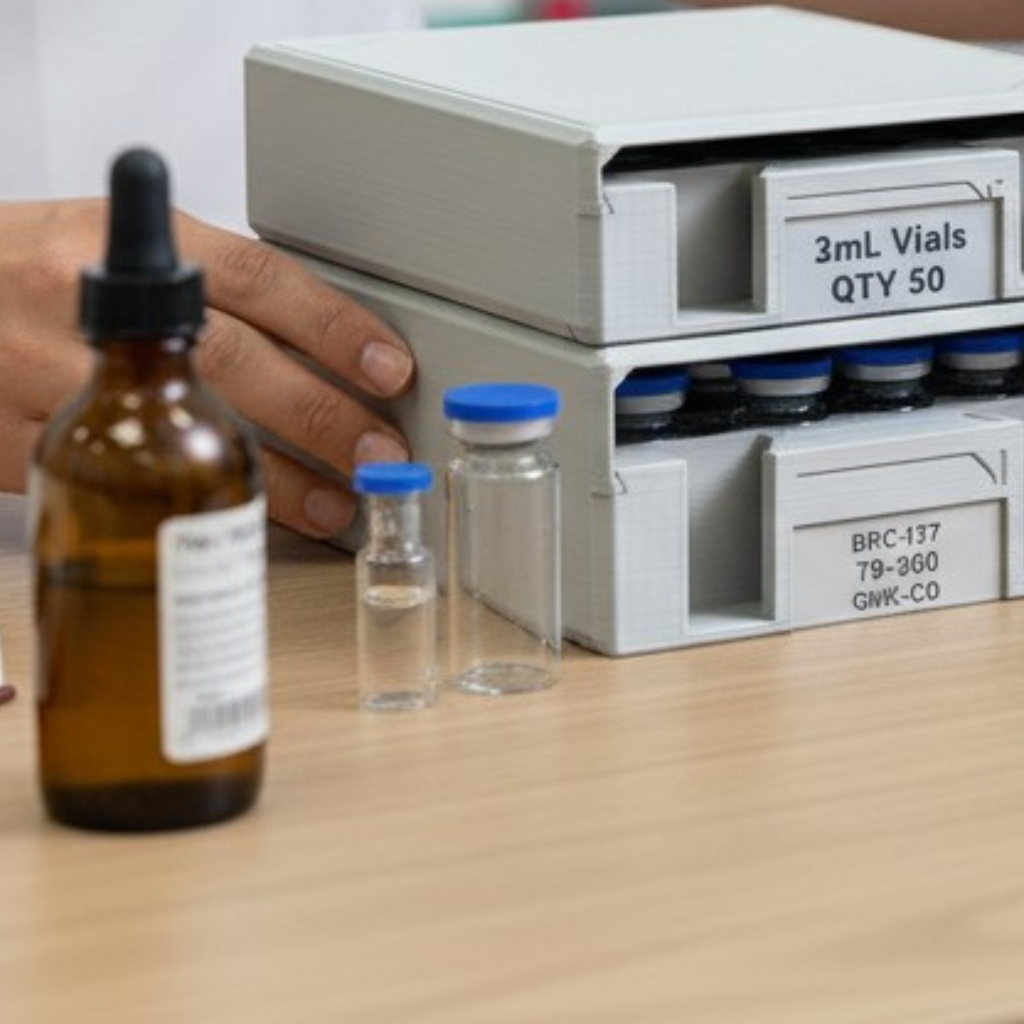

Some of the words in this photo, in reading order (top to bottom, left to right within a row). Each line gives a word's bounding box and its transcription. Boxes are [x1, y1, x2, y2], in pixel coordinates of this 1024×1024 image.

[813, 230, 882, 264] 3mL
[890, 221, 967, 255] Vials
[831, 269, 897, 304] QTY
[908, 265, 945, 295] 50
[851, 522, 941, 554] BRC-137
